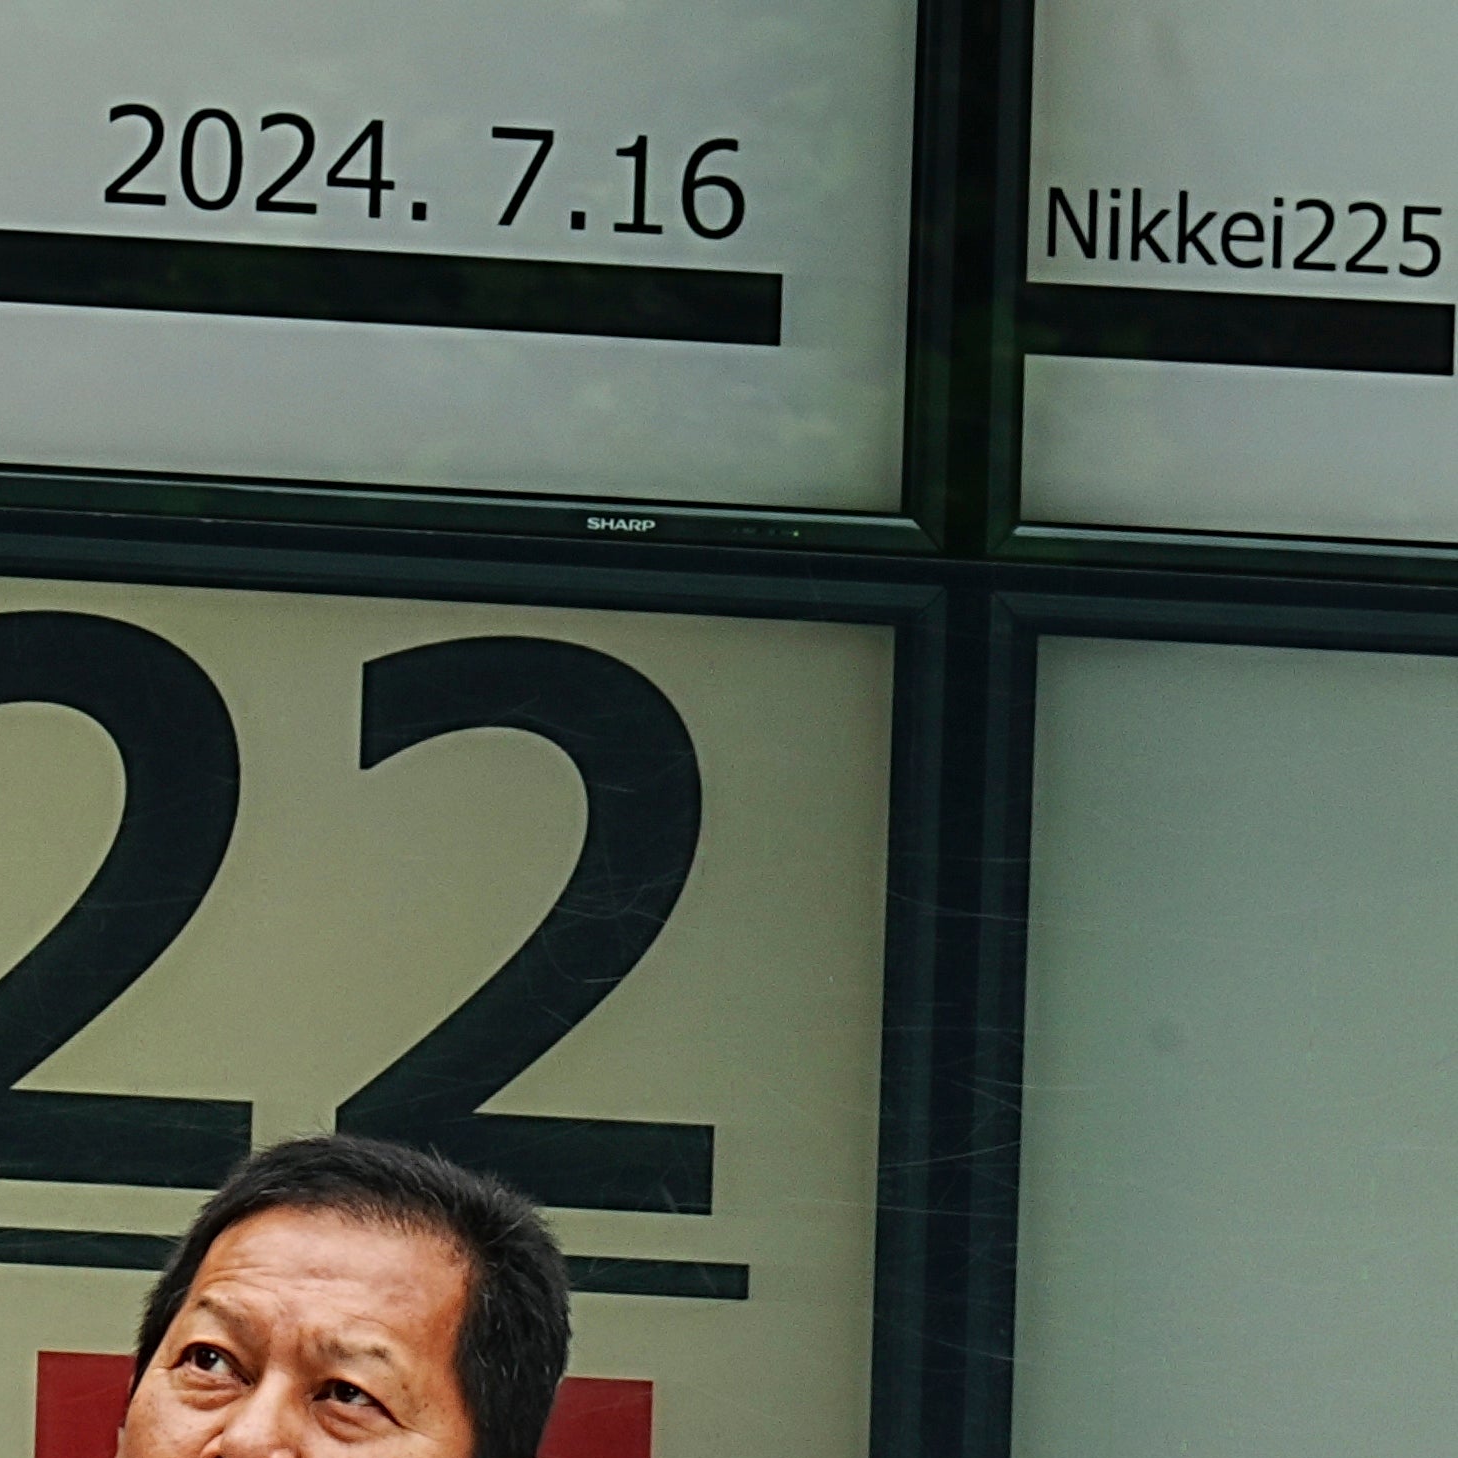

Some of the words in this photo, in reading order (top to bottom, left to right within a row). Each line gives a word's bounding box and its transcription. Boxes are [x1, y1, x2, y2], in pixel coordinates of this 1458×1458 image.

[103, 103, 429, 222] 2024.
[490, 125, 747, 240] 7.16
[1045, 185, 1444, 278] Nikkei225
[586, 516, 656, 532] SHARP
